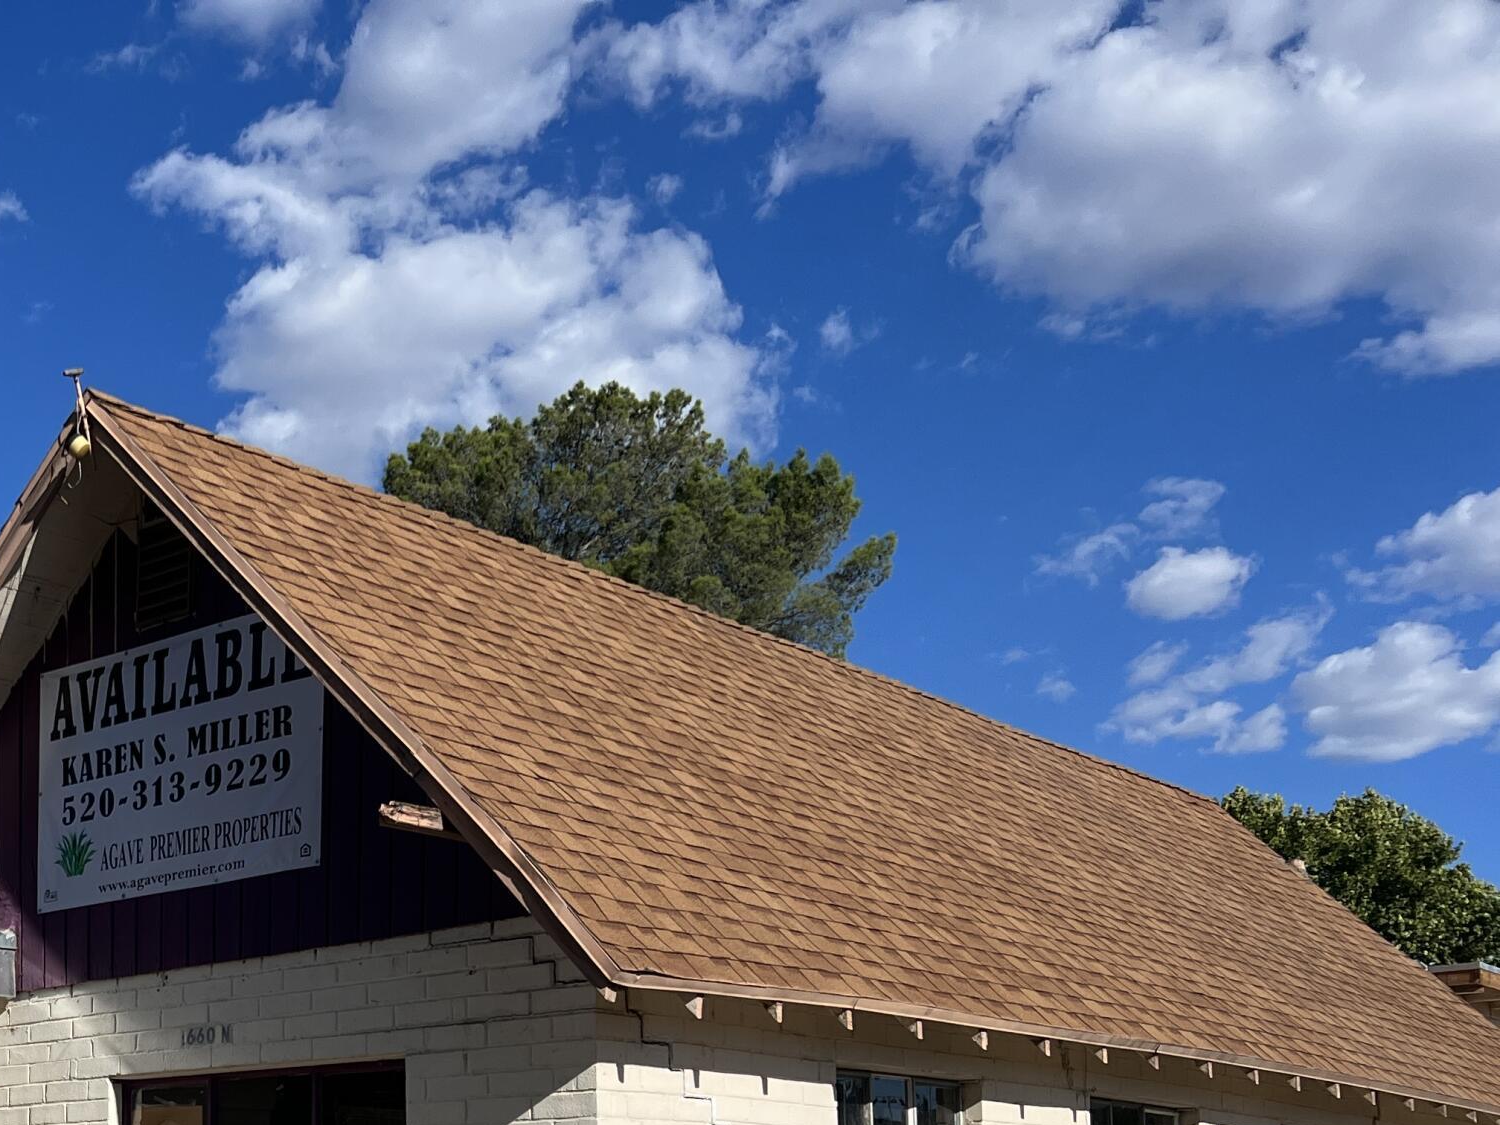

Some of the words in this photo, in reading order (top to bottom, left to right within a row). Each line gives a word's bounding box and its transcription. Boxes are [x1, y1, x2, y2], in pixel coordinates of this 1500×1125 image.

[61, 738, 145, 787] KAREN
[153, 733, 176, 766] S.
[187, 704, 293, 759] MILLER
[61, 748, 291, 826] 520-313-9229
[100, 838, 144, 872] AGAVE
[150, 825, 210, 862] PREMIER
[214, 807, 302, 855] PROPERTIES
[98, 859, 246, 893] www.agavepremier.com
[221, 1023, 231, 1044] N
